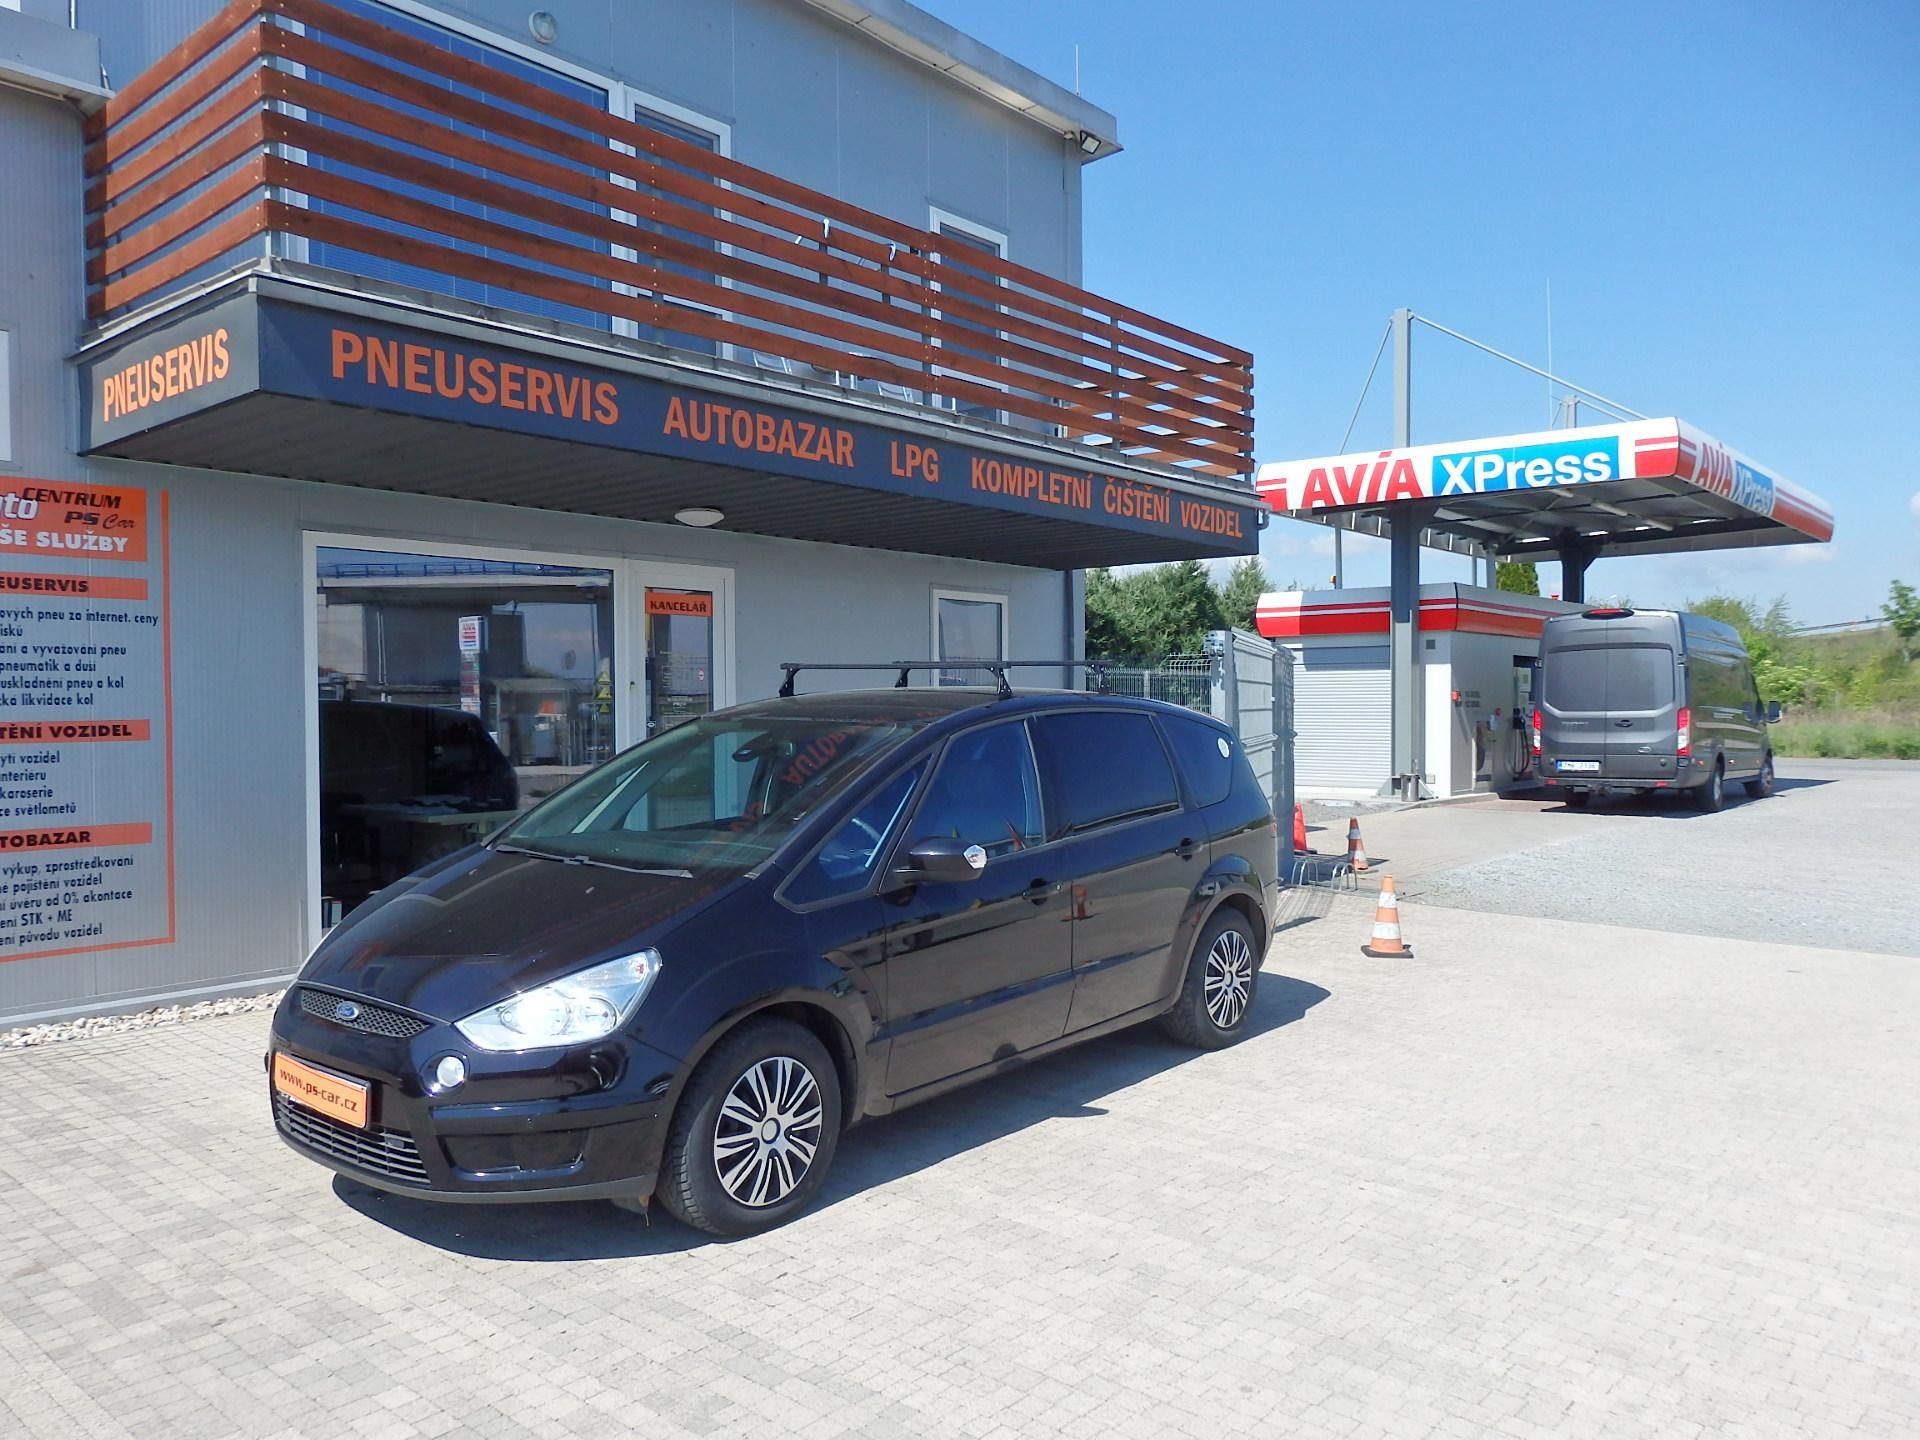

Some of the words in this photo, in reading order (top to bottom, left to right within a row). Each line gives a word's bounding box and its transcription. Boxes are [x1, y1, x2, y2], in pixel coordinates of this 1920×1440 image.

[103, 327, 229, 422] PNEUSERVIS
[331, 329, 619, 425] PNEUSERVIS
[663, 396, 854, 468] AUTOBAZAR
[890, 440, 939, 482] LPG
[972, 457, 1092, 509] KOMPLETNÍ
[1103, 476, 1170, 525] ČIŠTĚNÍ
[1180, 501, 1243, 538] VOZIDEL
[1440, 451, 1612, 496] XPress
[0, 492, 39, 520] to
[23, 487, 121, 509] CENTRUM
[64, 511, 100, 526] PS
[103, 513, 136, 529] Car
[36, 529, 128, 553] SLUŽBY
[38, 611, 64, 622] pneu
[69, 612, 82, 620] za
[86, 608, 131, 622] internet.
[134, 615, 158, 627] ceny
[21, 645, 28, 654] a
[101, 646, 126, 657] pneu
[64, 663, 71, 671] a
[66, 679, 93, 691] pneu
[97, 680, 104, 688] a
[107, 675, 124, 688] kol
[21, 692, 73, 706] likvidace
[76, 692, 94, 705] kol
[49, 724, 132, 738] VOZIDEL
[20, 750, 61, 764] vozidel
[0, 785, 54, 799] karoserie
[0, 831, 91, 848] TOBAZAR
[64, 872, 102, 887] vozidel
[46, 894, 60, 907] od
[63, 891, 80, 905] 0%
[83, 890, 133, 903] akontace
[21, 912, 44, 926] STK
[57, 909, 73, 923] ME
[64, 922, 103, 939] vozidel
[280, 1069, 358, 1113] www.ps-car.cz
